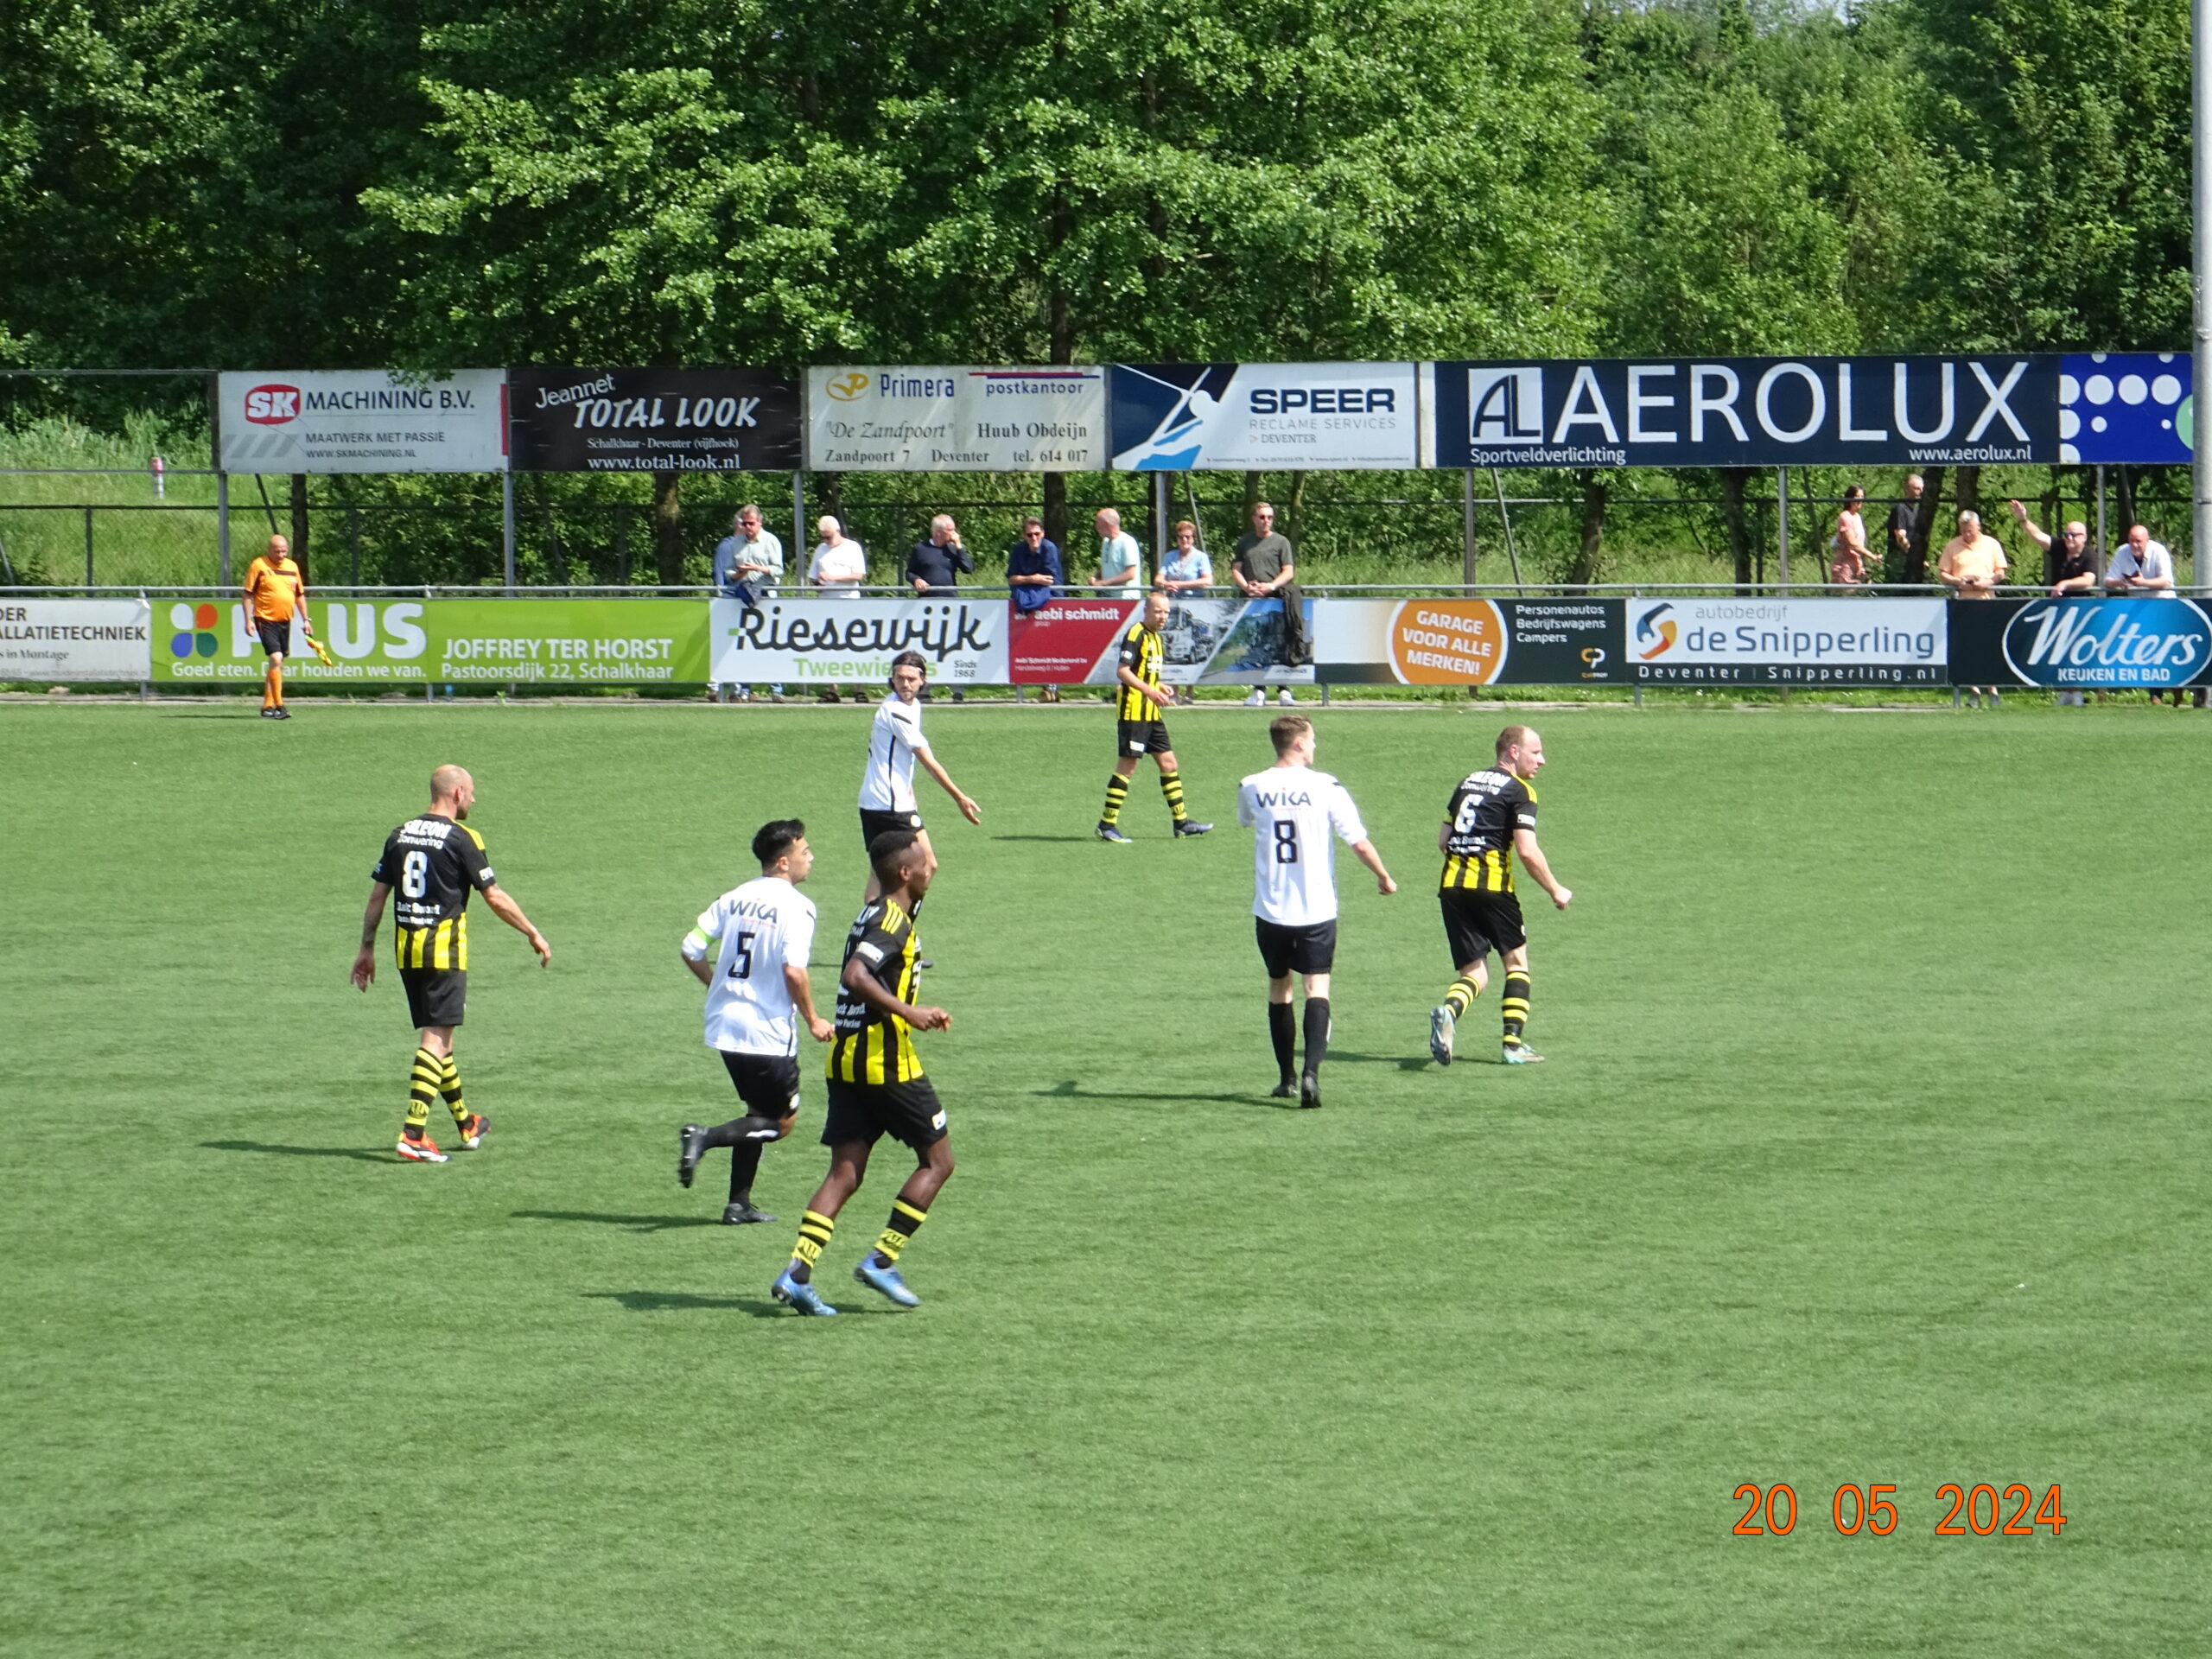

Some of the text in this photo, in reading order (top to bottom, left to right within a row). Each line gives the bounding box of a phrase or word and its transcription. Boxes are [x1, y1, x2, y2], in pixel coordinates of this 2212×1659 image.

[535, 372, 616, 410] Jeannet
[880, 374, 1084, 397] Primera postkantoor
[247, 391, 299, 419] SK
[306, 390, 476, 410] MACHINING B.V.
[1249, 388, 1395, 414] SPEER
[1552, 362, 2031, 444] AEROLUX
[574, 397, 760, 429] TOTAL LOOK
[977, 423, 1020, 438] Huub
[1027, 422, 1088, 441] Obdeijn
[1249, 417, 1396, 430] RECLAME SERVICES
[305, 432, 446, 444] MAATWERK MET PASSIE
[588, 437, 640, 449] Schalkhaar
[648, 437, 691, 448] Deventer
[1261, 434, 1317, 443] DEVENTER
[306, 448, 418, 459] WWW.SKMACHINING.NL
[588, 454, 741, 469] www.total-look.nl
[825, 449, 1088, 465] Zandpoort 7 Deventer tel. 614 017
[1470, 445, 2031, 466] Sportveldverlichting www.aerolux.nl
[1034, 607, 1120, 620] aebi schmidt
[1516, 604, 1605, 616] Personenautos
[1695, 604, 1788, 620] autobedrijf
[1416, 609, 1484, 636] GARAGE
[1516, 618, 1606, 632] Bedrijfswagens
[0, 626, 147, 640] LLATIETECHNIEK
[736, 605, 991, 663] Riesewijk
[1402, 627, 1492, 658] VOOR ALLE
[1516, 632, 1567, 645] Campers
[1687, 626, 1935, 658] de Snipperling
[2024, 606, 2203, 666] Wolters
[20, 650, 69, 661] Montage
[442, 638, 672, 660] JOFFREY TER HORST
[172, 661, 215, 677] Goed
[218, 663, 257, 677] eten.
[302, 662, 365, 677] houden
[368, 665, 389, 677] we
[393, 664, 426, 677] van.
[442, 662, 673, 682] Pastoorsdijk 22, Schalkhaar
[1406, 650, 1480, 676] MERKEN!
[1638, 665, 1936, 681] Deventer Snipperling.nl
[2057, 668, 2171, 683] KEUKEN EN BAD
[1454, 794, 1484, 833] 6
[1274, 820, 1298, 863] 8
[403, 850, 428, 899] 8
[728, 931, 755, 979] 5
